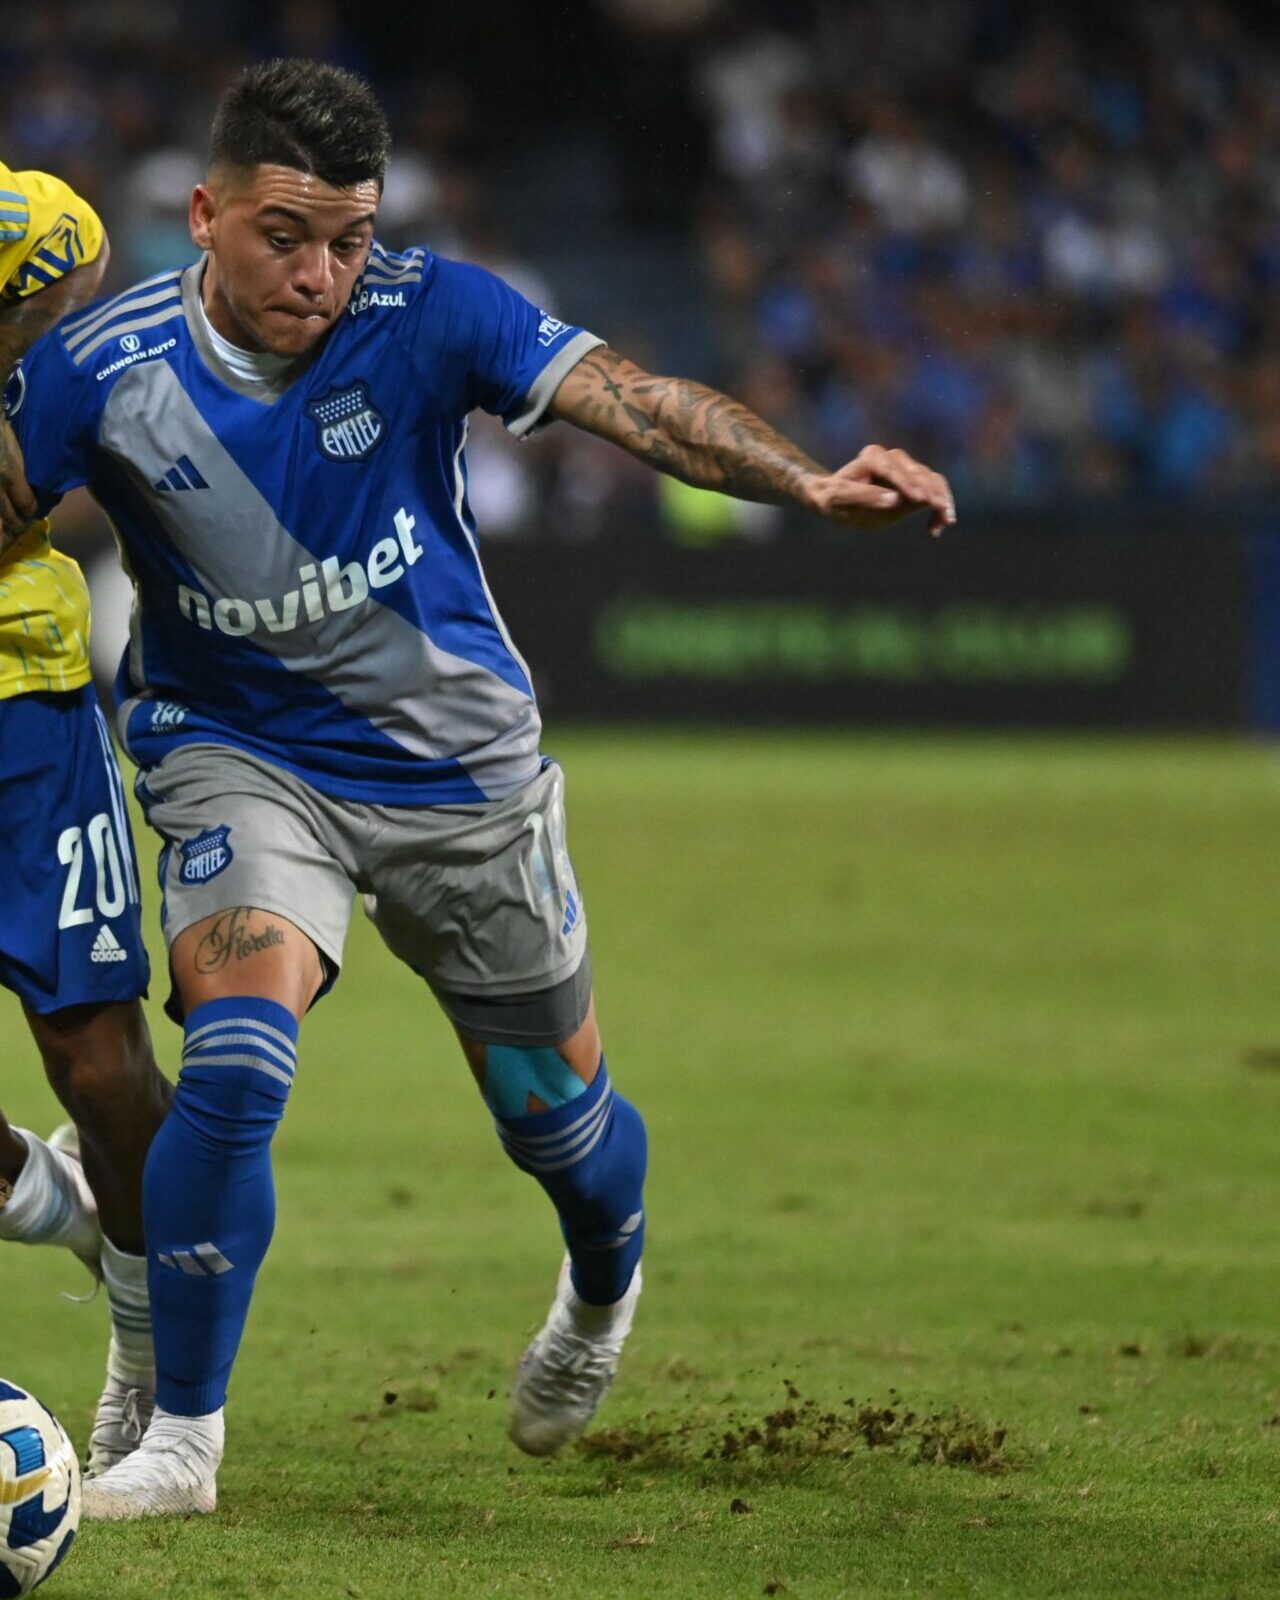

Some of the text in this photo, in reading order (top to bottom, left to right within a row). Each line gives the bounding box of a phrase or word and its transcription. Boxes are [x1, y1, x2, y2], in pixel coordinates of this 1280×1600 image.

[96, 337, 177, 381] CHANGAN AUTO
[322, 410, 381, 456] EMELEC
[177, 507, 424, 636] novibet
[58, 813, 126, 930] 20
[184, 847, 227, 878] EMELEC
[90, 949, 128, 963] adidas
